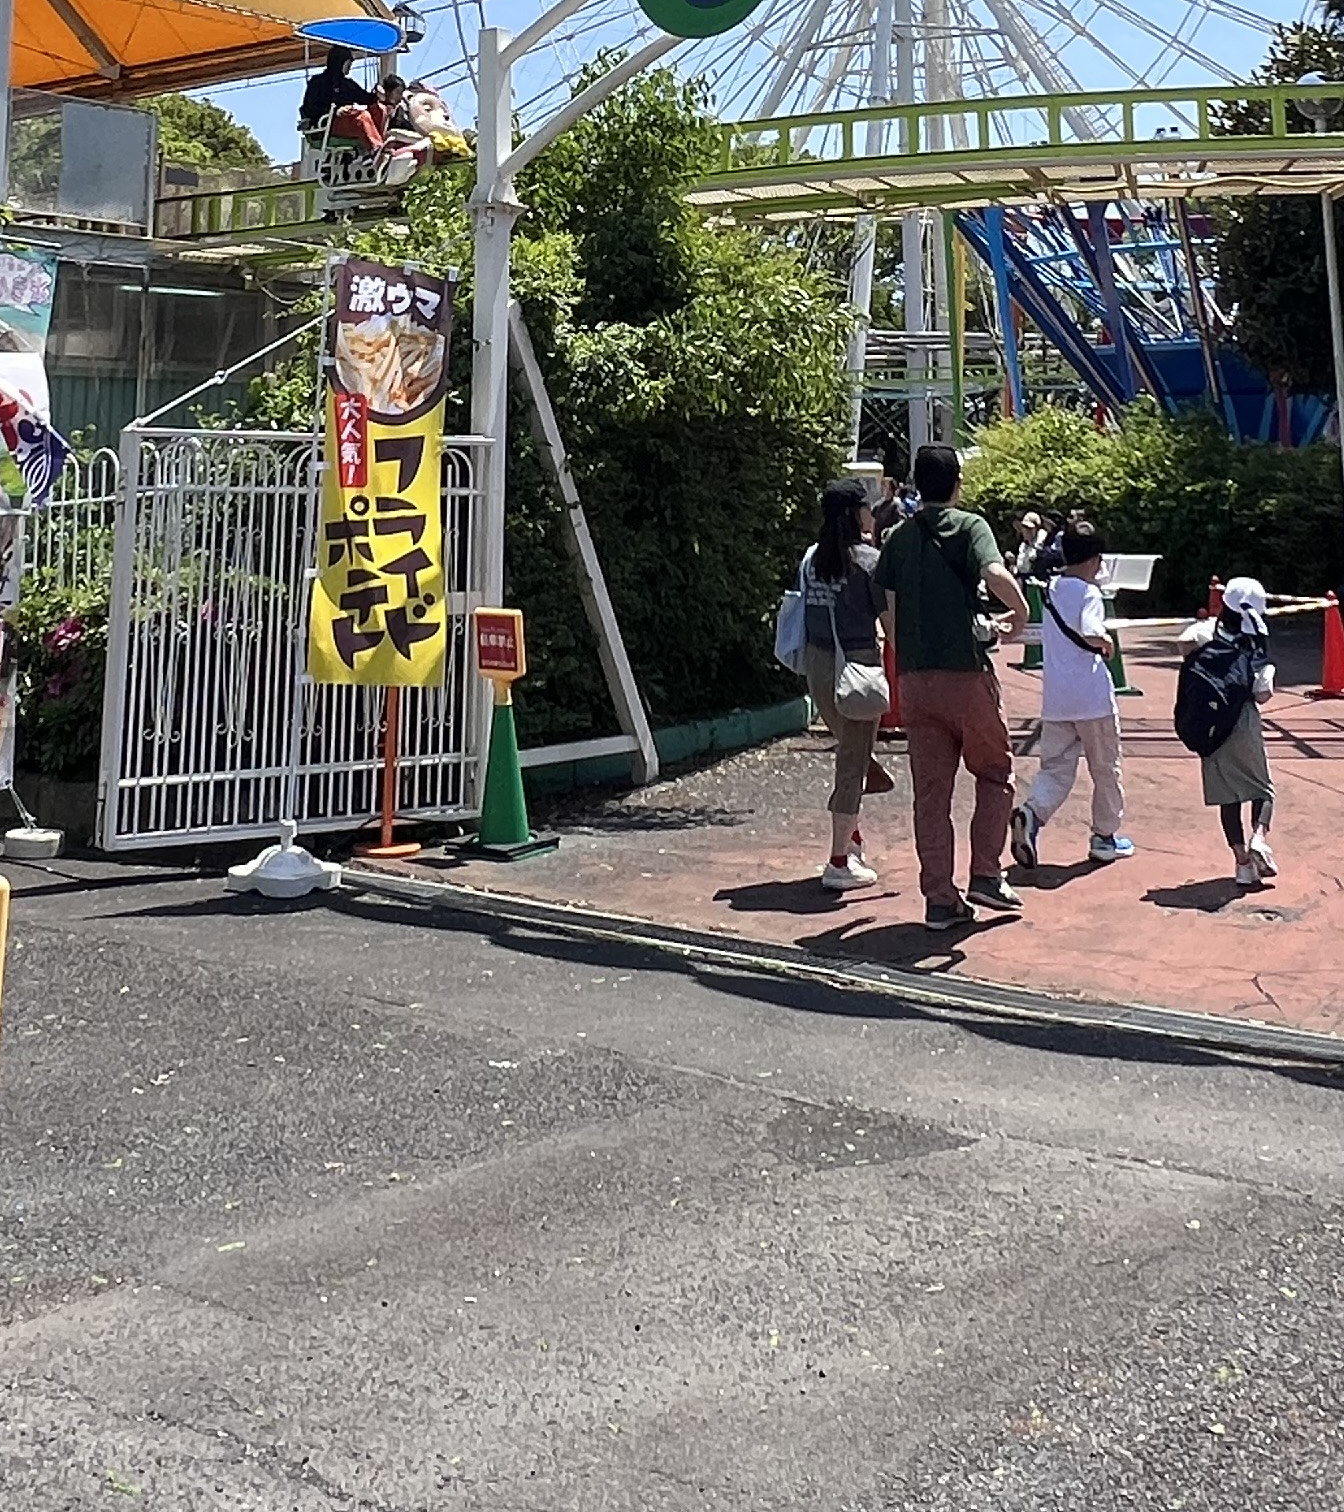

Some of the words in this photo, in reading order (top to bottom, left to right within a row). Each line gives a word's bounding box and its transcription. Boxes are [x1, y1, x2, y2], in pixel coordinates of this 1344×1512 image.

[348, 274, 442, 321] 激ウマ
[323, 494, 389, 670] ポテト
[372, 435, 441, 662] フライド
